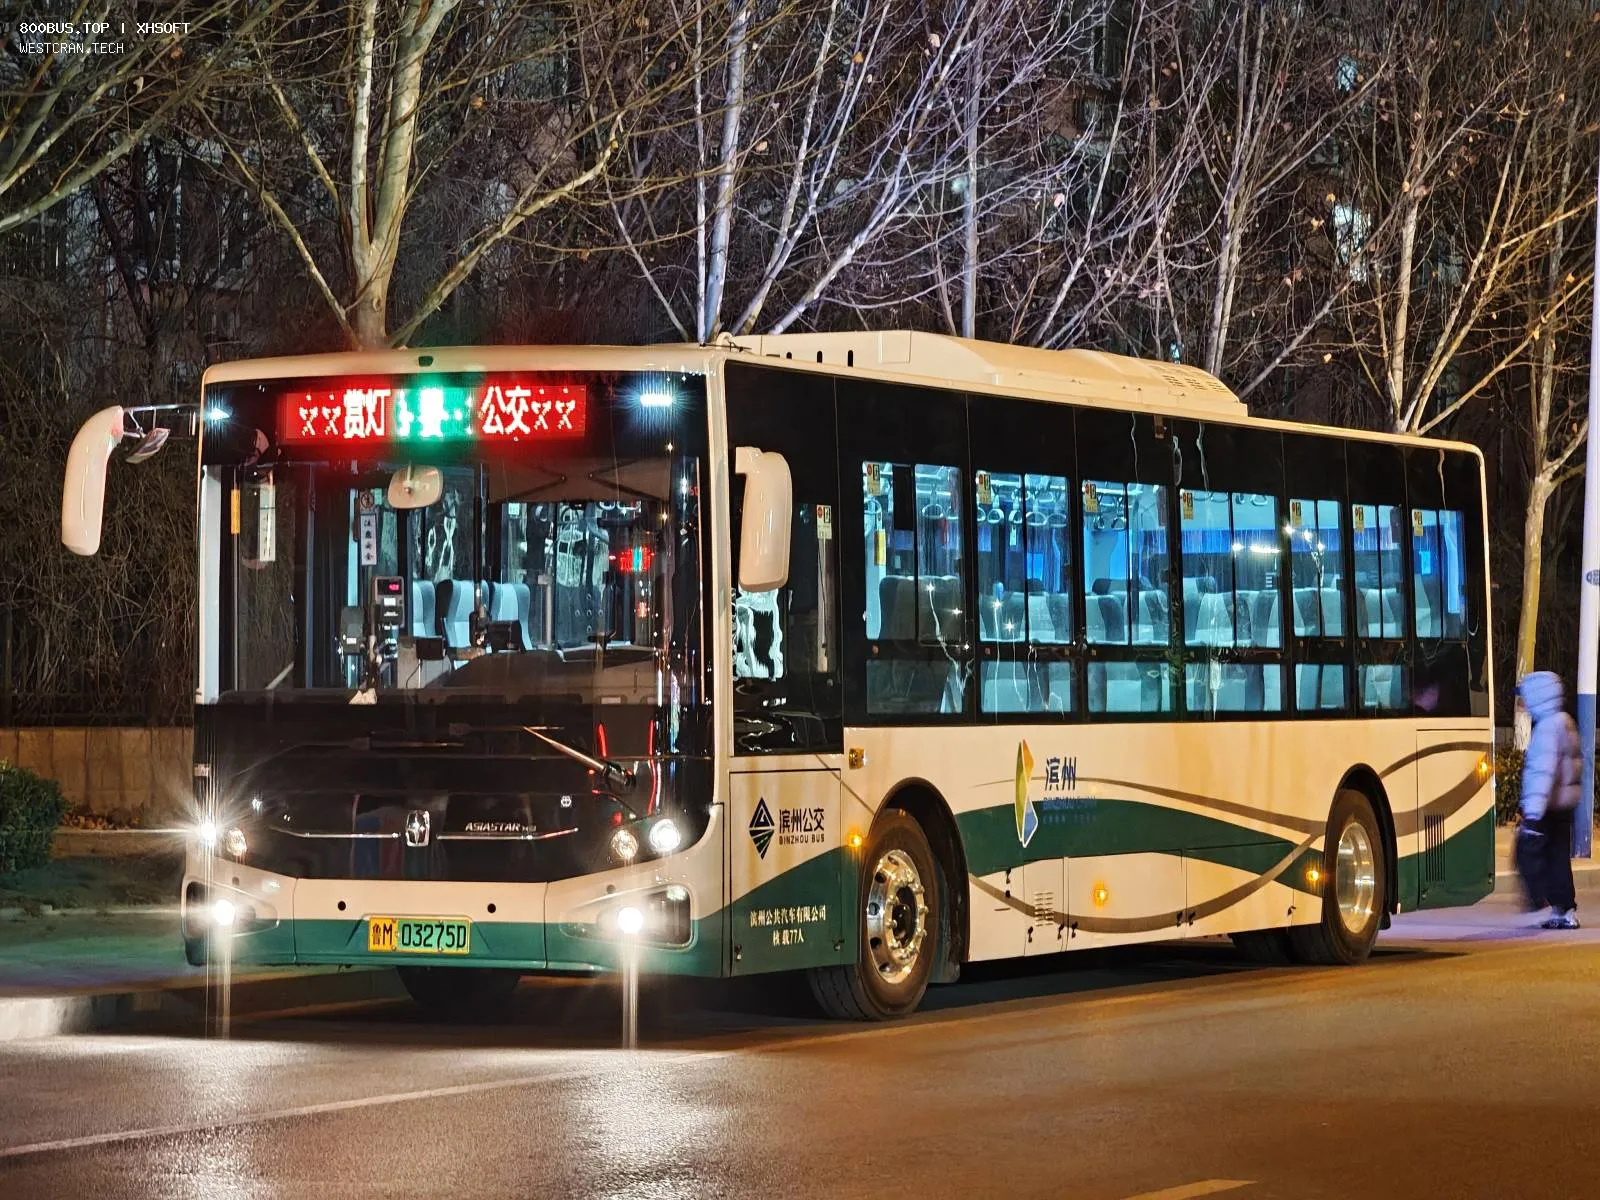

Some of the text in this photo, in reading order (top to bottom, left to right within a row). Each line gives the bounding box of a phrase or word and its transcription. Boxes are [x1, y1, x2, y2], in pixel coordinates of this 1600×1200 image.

[481, 385, 531, 436] 公交
[1045, 756, 1076, 791] 滨州
[465, 822, 521, 832] ASIASTAR
[779, 808, 825, 834] 滨州公交
[811, 833, 825, 843] BUS
[750, 904, 826, 928] 滨州公共汽车有限公司
[401, 923, 467, 949] 03275D
